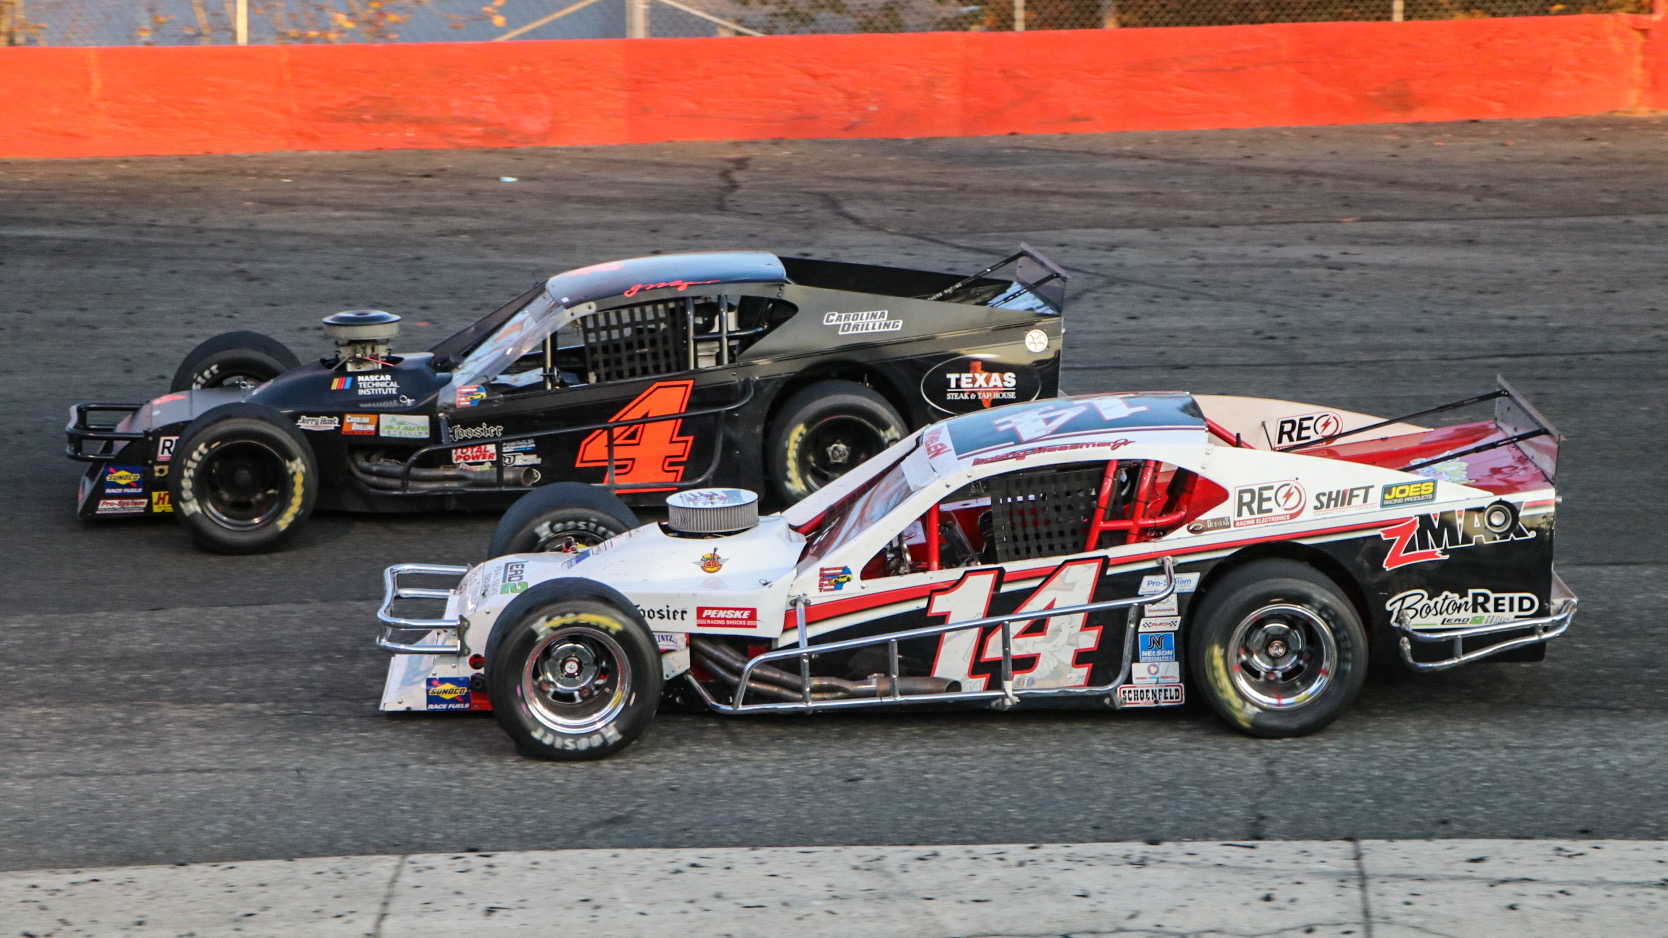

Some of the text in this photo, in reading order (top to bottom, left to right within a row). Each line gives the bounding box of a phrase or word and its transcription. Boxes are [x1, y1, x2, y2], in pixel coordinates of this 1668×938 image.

[824, 311, 887, 324] CAROLINA
[840, 320, 901, 333] DRILLING
[946, 372, 1017, 388] TEXAS
[946, 392, 970, 400] STEAK
[970, 392, 977, 400] &
[993, 391, 1016, 399] HOUSE
[449, 423, 504, 441] Hoosier
[575, 380, 696, 494] 4
[454, 445, 490, 455] TOTAL
[454, 453, 496, 462] POWER
[1384, 481, 1434, 500] JOES
[1313, 485, 1375, 511] SHIFT
[1404, 494, 1434, 503] PRODUCTS
[1235, 514, 1291, 528] RACING ELECTRONICS
[1147, 579, 1192, 587] Pro-Stem
[635, 604, 688, 621] oosier
[702, 609, 752, 619] PENSKE
[927, 557, 1104, 692] 14
[654, 634, 674, 644] INTZ
[1122, 688, 1181, 702] SCHOENFELD
